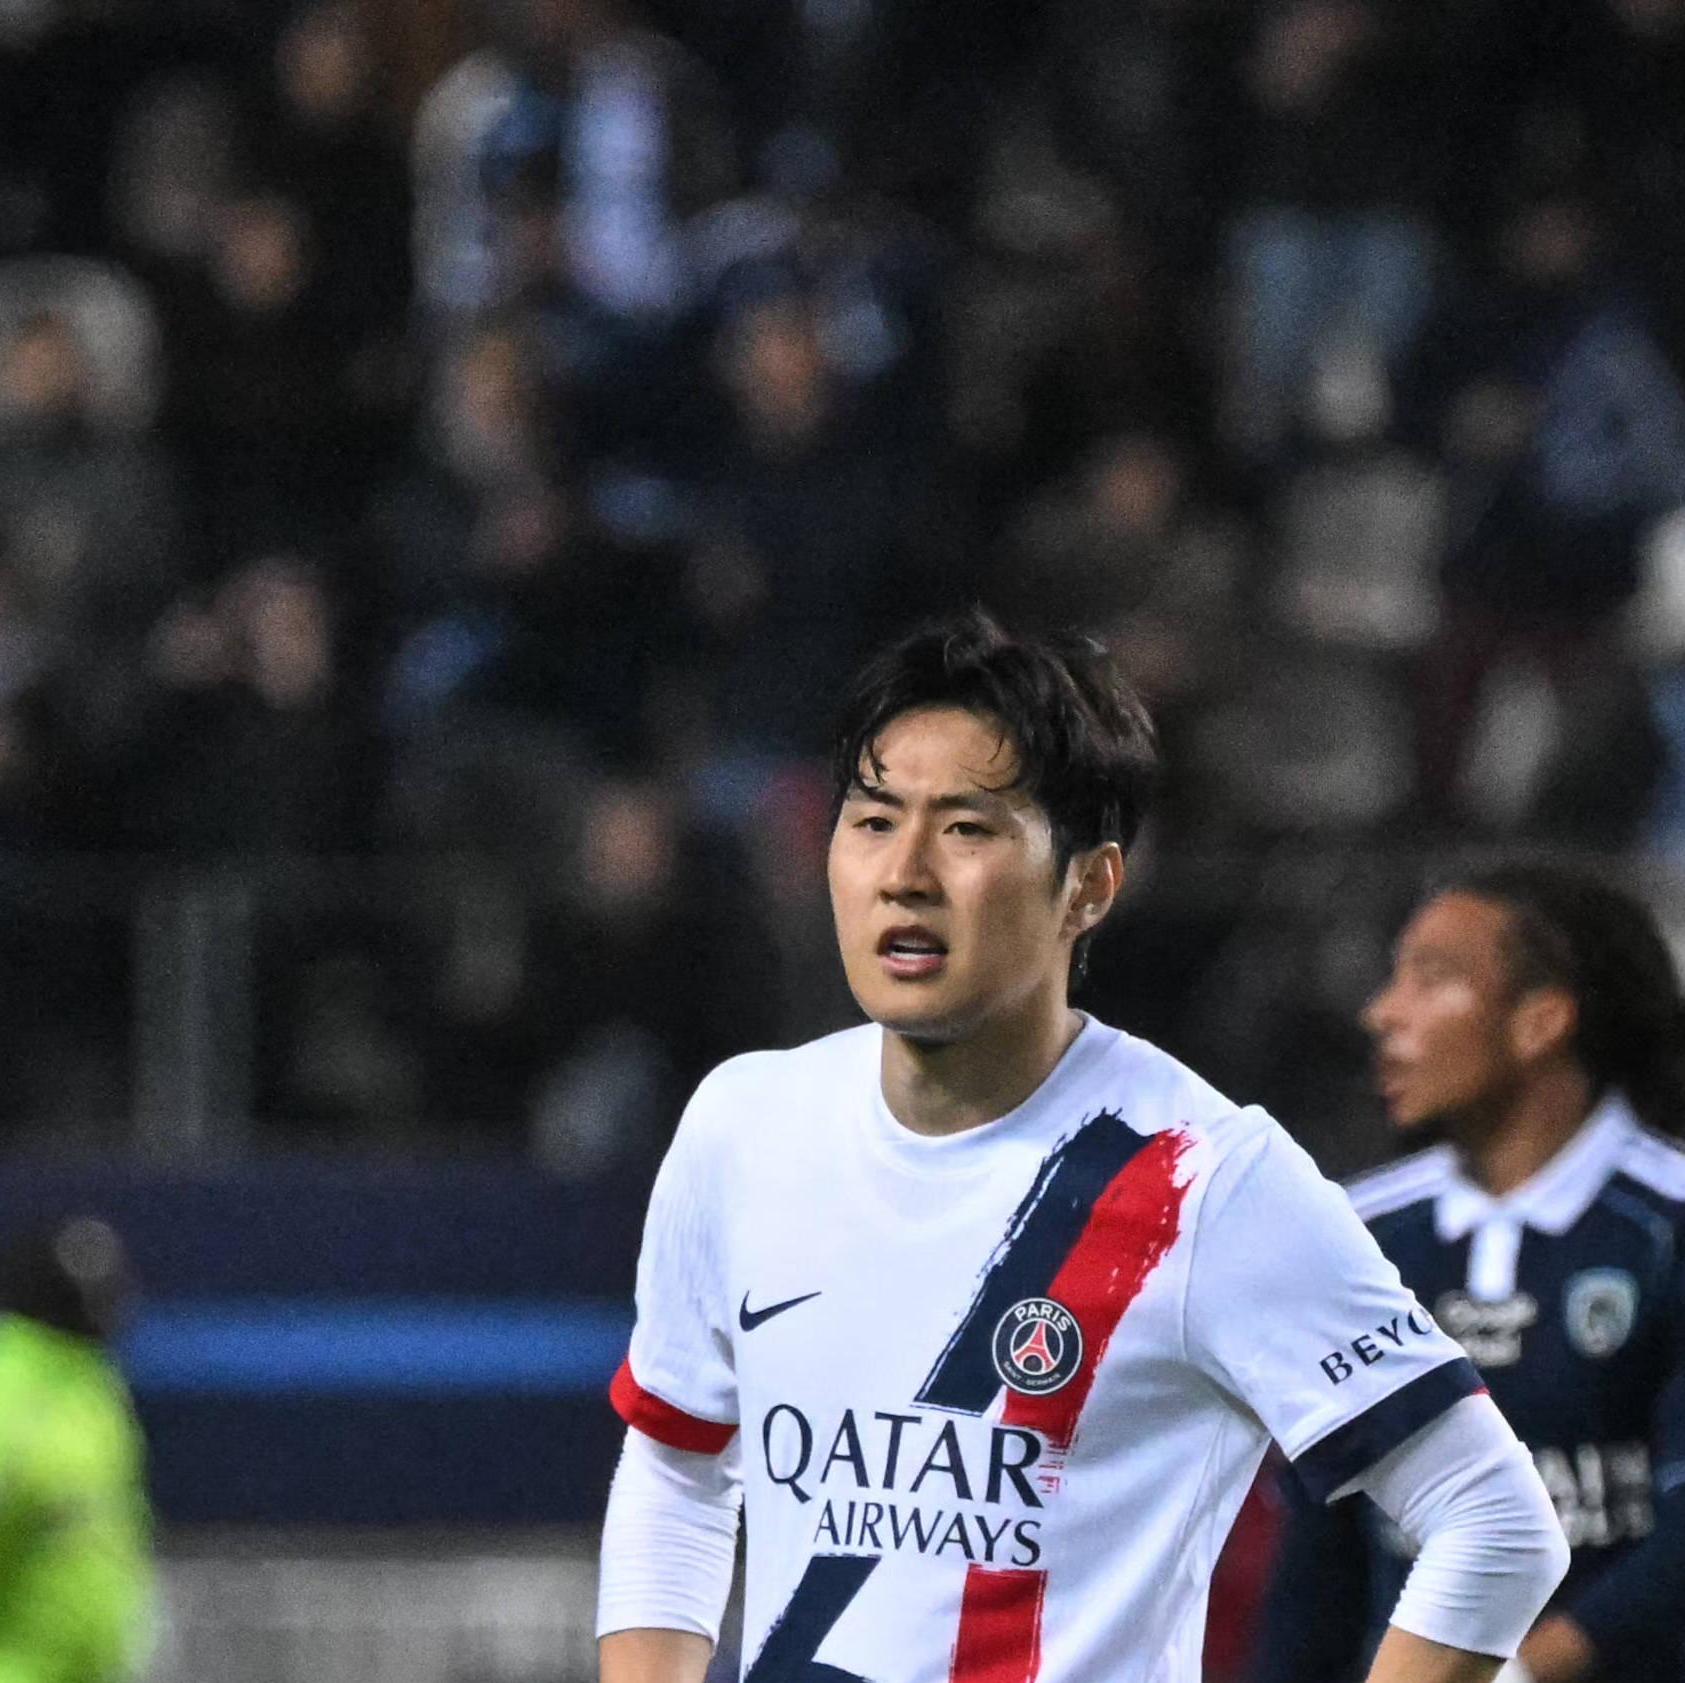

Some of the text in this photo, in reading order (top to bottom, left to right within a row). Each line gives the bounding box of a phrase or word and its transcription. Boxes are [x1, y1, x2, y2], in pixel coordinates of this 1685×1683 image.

[1014, 1303, 1072, 1332] PARIS
[762, 1403, 1045, 1509] QATAR
[814, 1498, 1042, 1567] AIRWAYS
